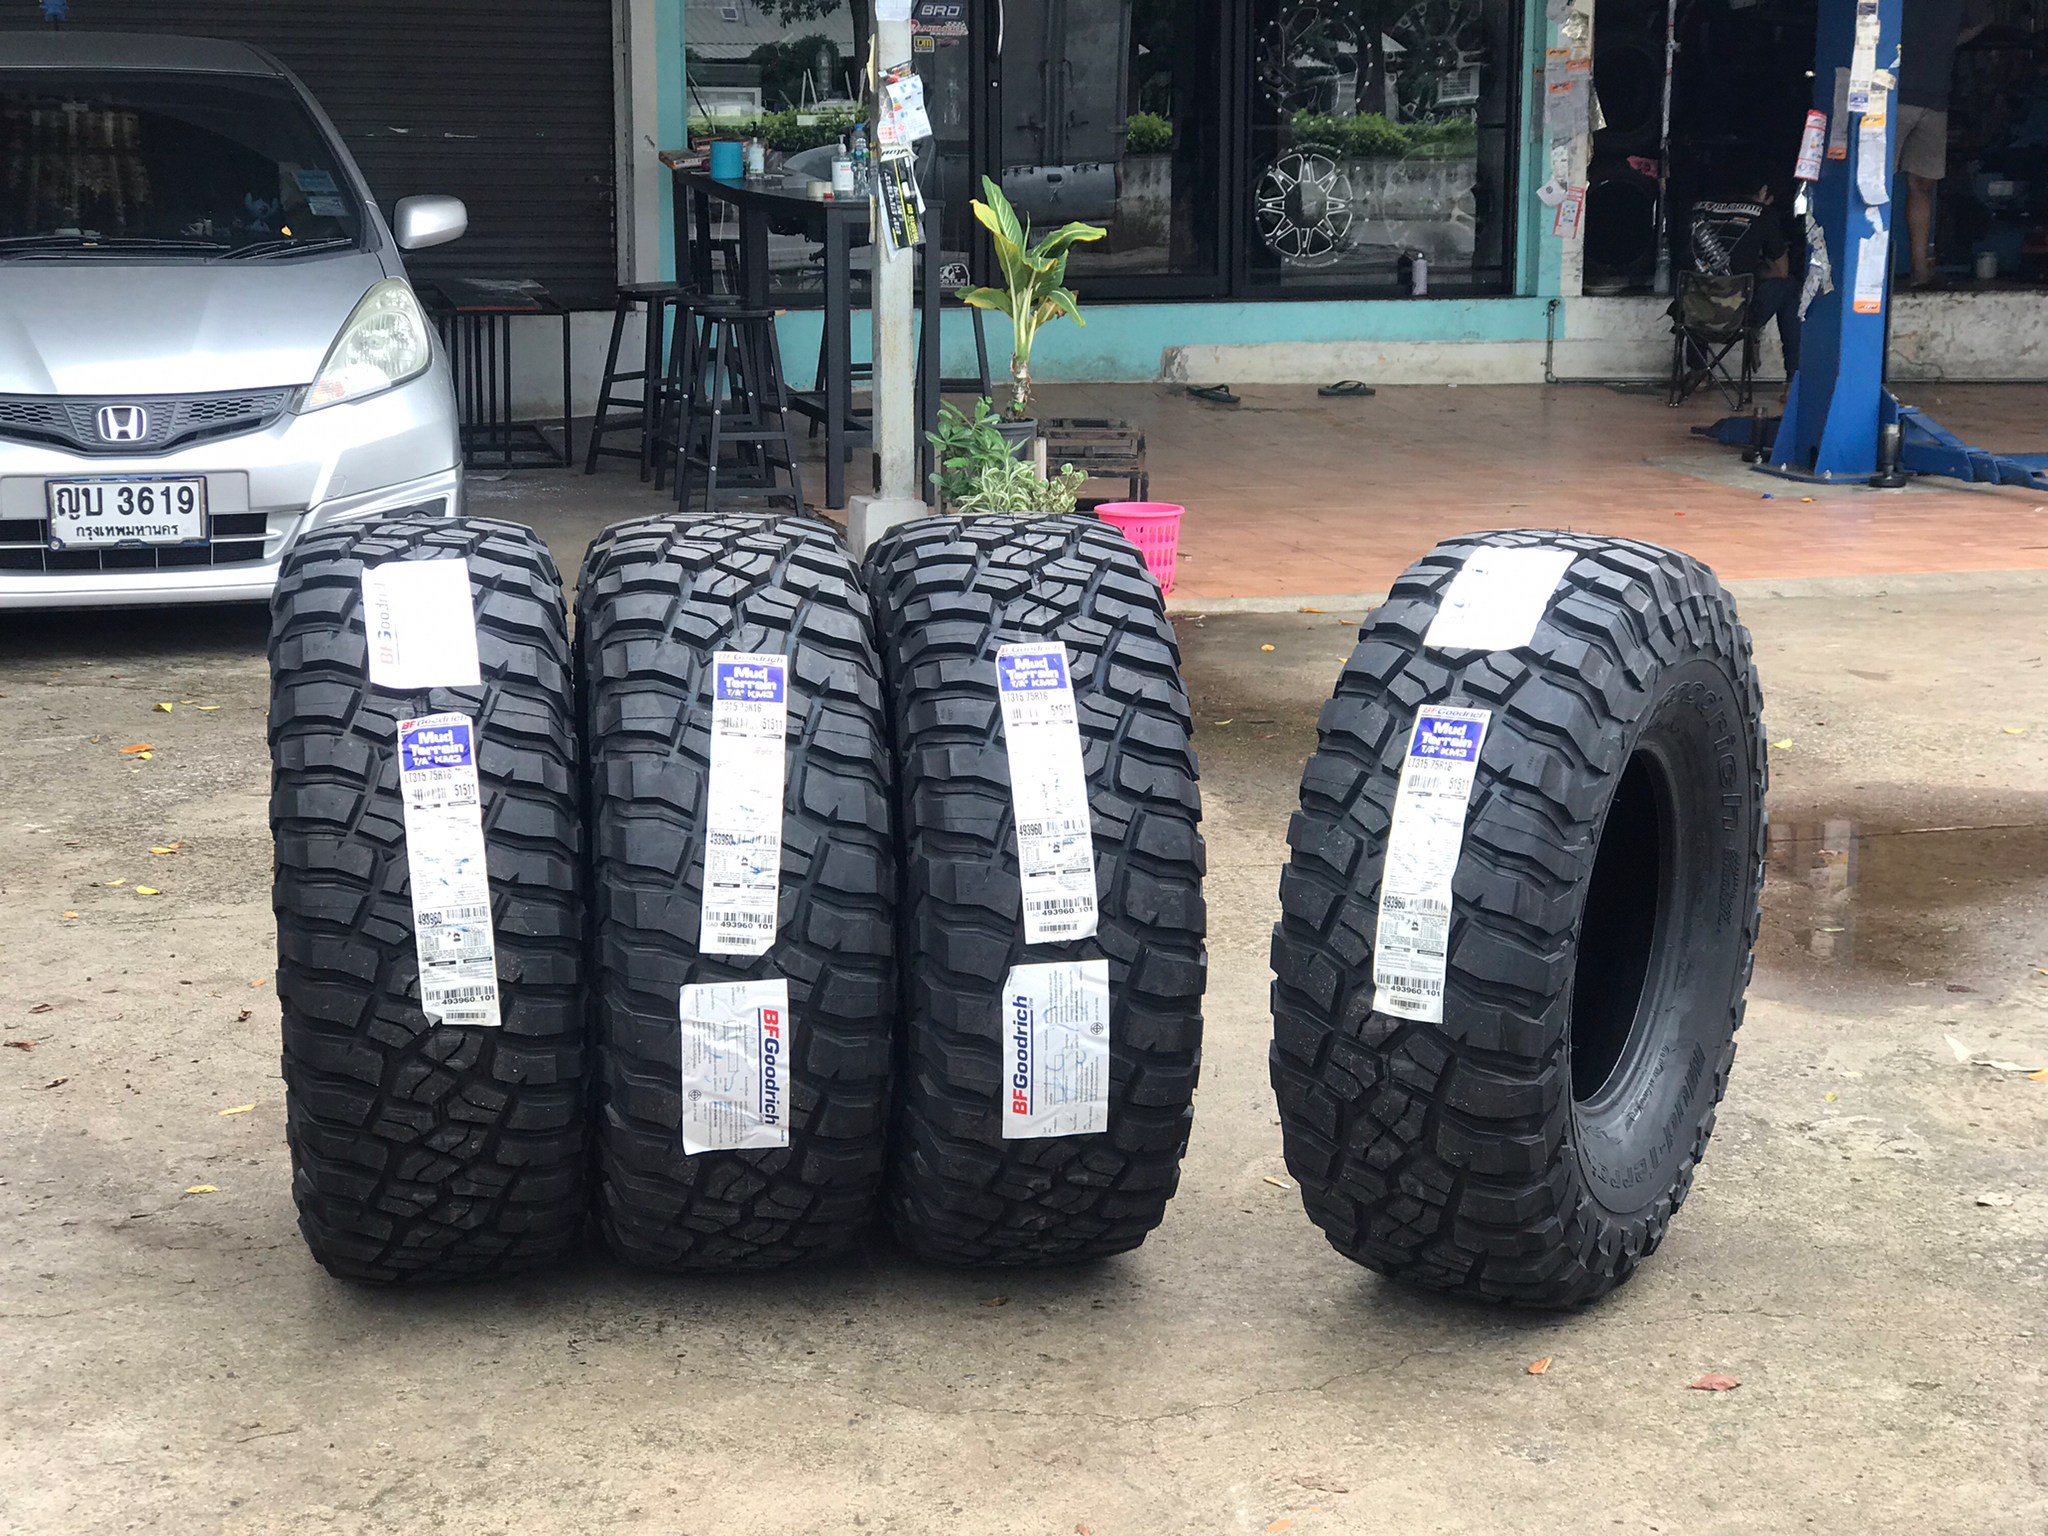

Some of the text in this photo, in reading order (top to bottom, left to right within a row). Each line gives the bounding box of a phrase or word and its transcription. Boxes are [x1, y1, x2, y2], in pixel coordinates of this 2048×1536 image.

[921, 4, 961, 16] BRD
[56, 485, 194, 520] ญบ 3619
[76, 524, 179, 540] กรุงเทพมหานคร
[1013, 656, 1049, 670] Mud
[733, 666, 768, 679] Mud
[1006, 668, 1060, 681] Terrain
[723, 676, 777, 691] Terrain
[1433, 721, 1468, 736] Mud
[417, 729, 454, 744] Mud
[1421, 731, 1473, 748] Terrain
[408, 742, 464, 756] Terrain
[1019, 823, 1043, 836] 493960
[1041, 907, 1075, 916] 493960
[1079, 905, 1094, 913] 101
[720, 920, 754, 929] 493960
[1390, 985, 1422, 995] 493960
[1426, 988, 1441, 998] 101
[441, 996, 476, 1005] 493960
[479, 994, 496, 1002] 101
[1012, 995, 1028, 1116] BFGoodrich
[763, 1007, 780, 1126] BFGoodrich
